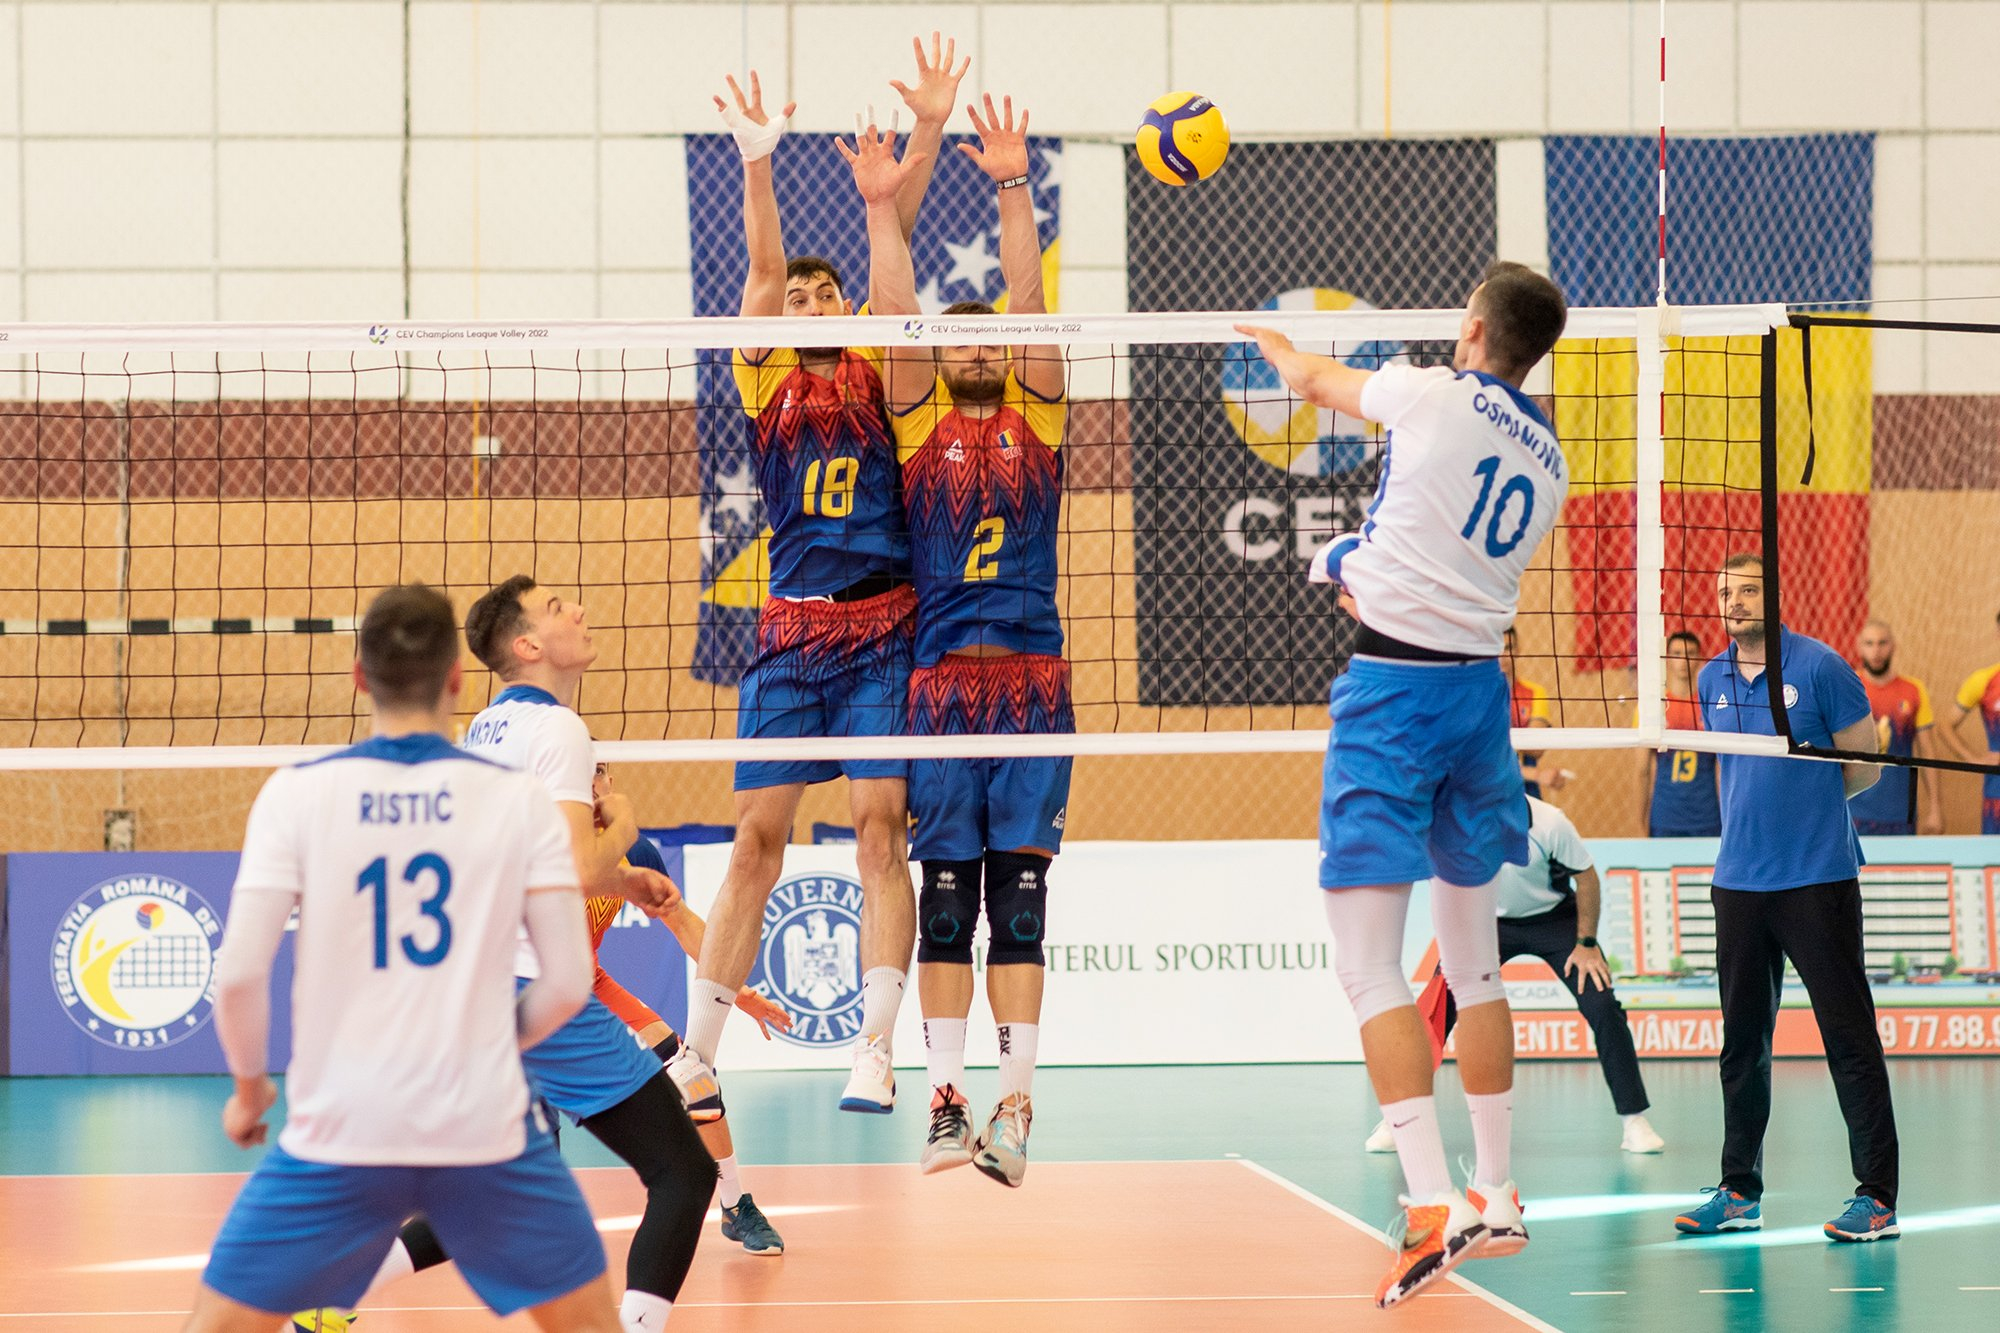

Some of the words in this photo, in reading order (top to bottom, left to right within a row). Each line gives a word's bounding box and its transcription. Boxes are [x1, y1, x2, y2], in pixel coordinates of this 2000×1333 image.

[396, 330, 414, 338] CEV
[416, 329, 464, 339] Champions
[466, 330, 498, 340] League
[500, 329, 526, 339] Volley
[528, 329, 549, 338] 2022
[930, 325, 949, 333] CEV
[950, 324, 999, 334] Champions
[1001, 324, 1032, 334] League
[1033, 324, 1059, 333] Volley
[1062, 324, 1082, 332] 2022
[944, 451, 965, 463] PEAK
[803, 457, 859, 518] 18
[1461, 455, 1535, 558] 10
[963, 516, 1005, 583] 2
[1671, 751, 1698, 783] 13
[360, 783, 452, 824] RISTIĆ
[195, 906, 219, 937] DE
[357, 851, 453, 969] 13
[1155, 943, 1329, 972] SPORTULUI
[114, 1027, 168, 1047] 1931
[997, 1026, 1011, 1057] PEAK
[1514, 1020, 1583, 1051] ENTE
